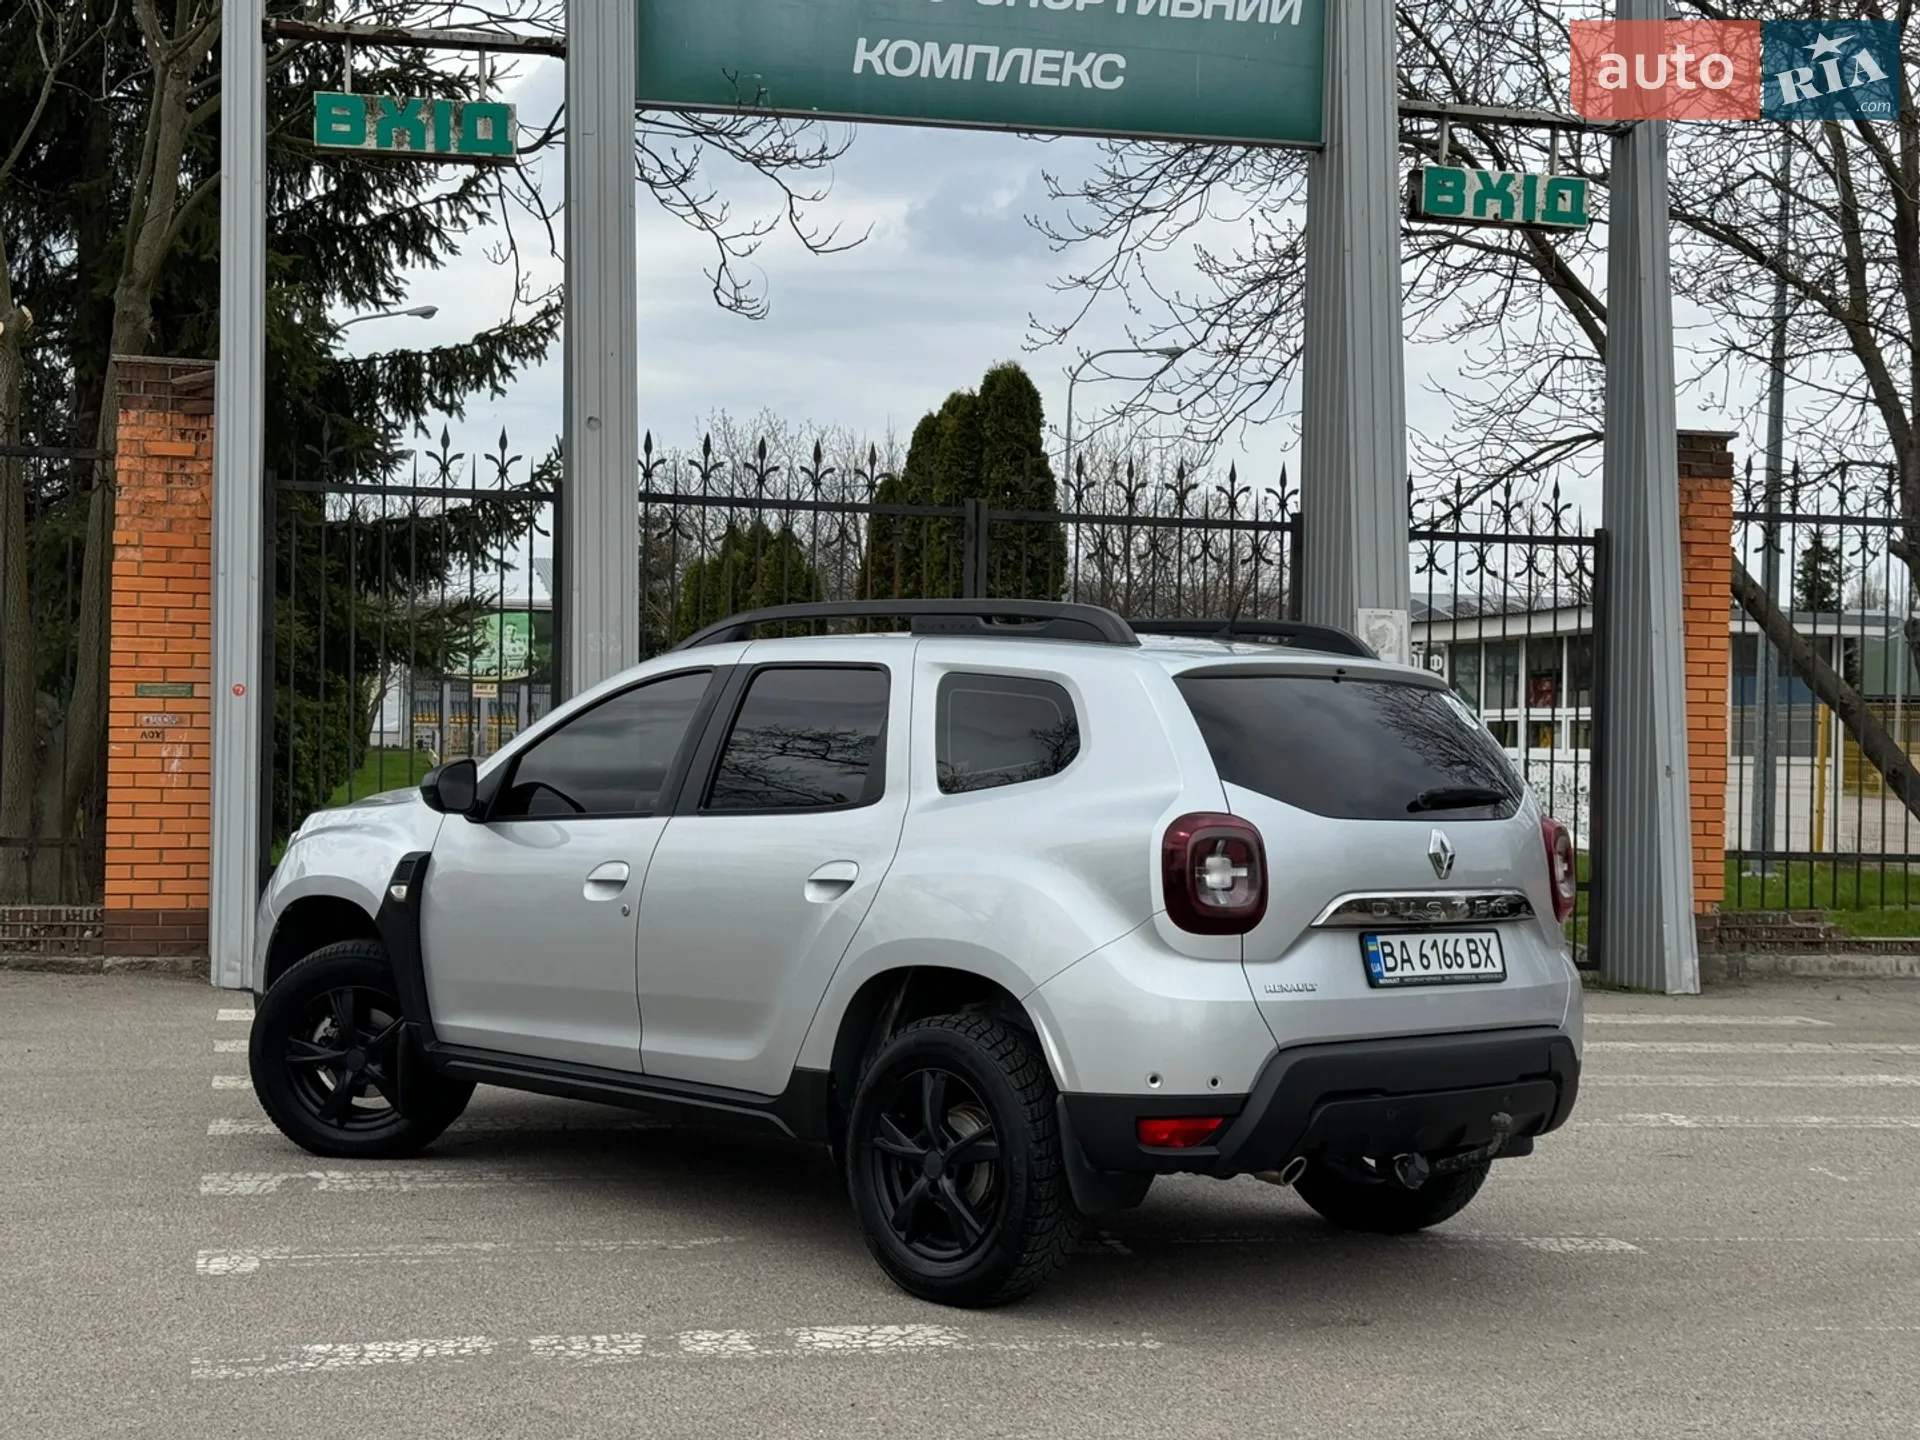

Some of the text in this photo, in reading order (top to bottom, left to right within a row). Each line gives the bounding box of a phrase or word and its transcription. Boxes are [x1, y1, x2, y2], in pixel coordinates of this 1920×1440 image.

[853, 37, 1127, 90] КОМПЛЕКС
[315, 94, 513, 155] ВХІД
[1424, 167, 1588, 224] ВХІД
[1372, 899, 1510, 919] DUSTER
[1379, 937, 1496, 972] BA 6166 BX
[1264, 983, 1317, 993] RENAULT
